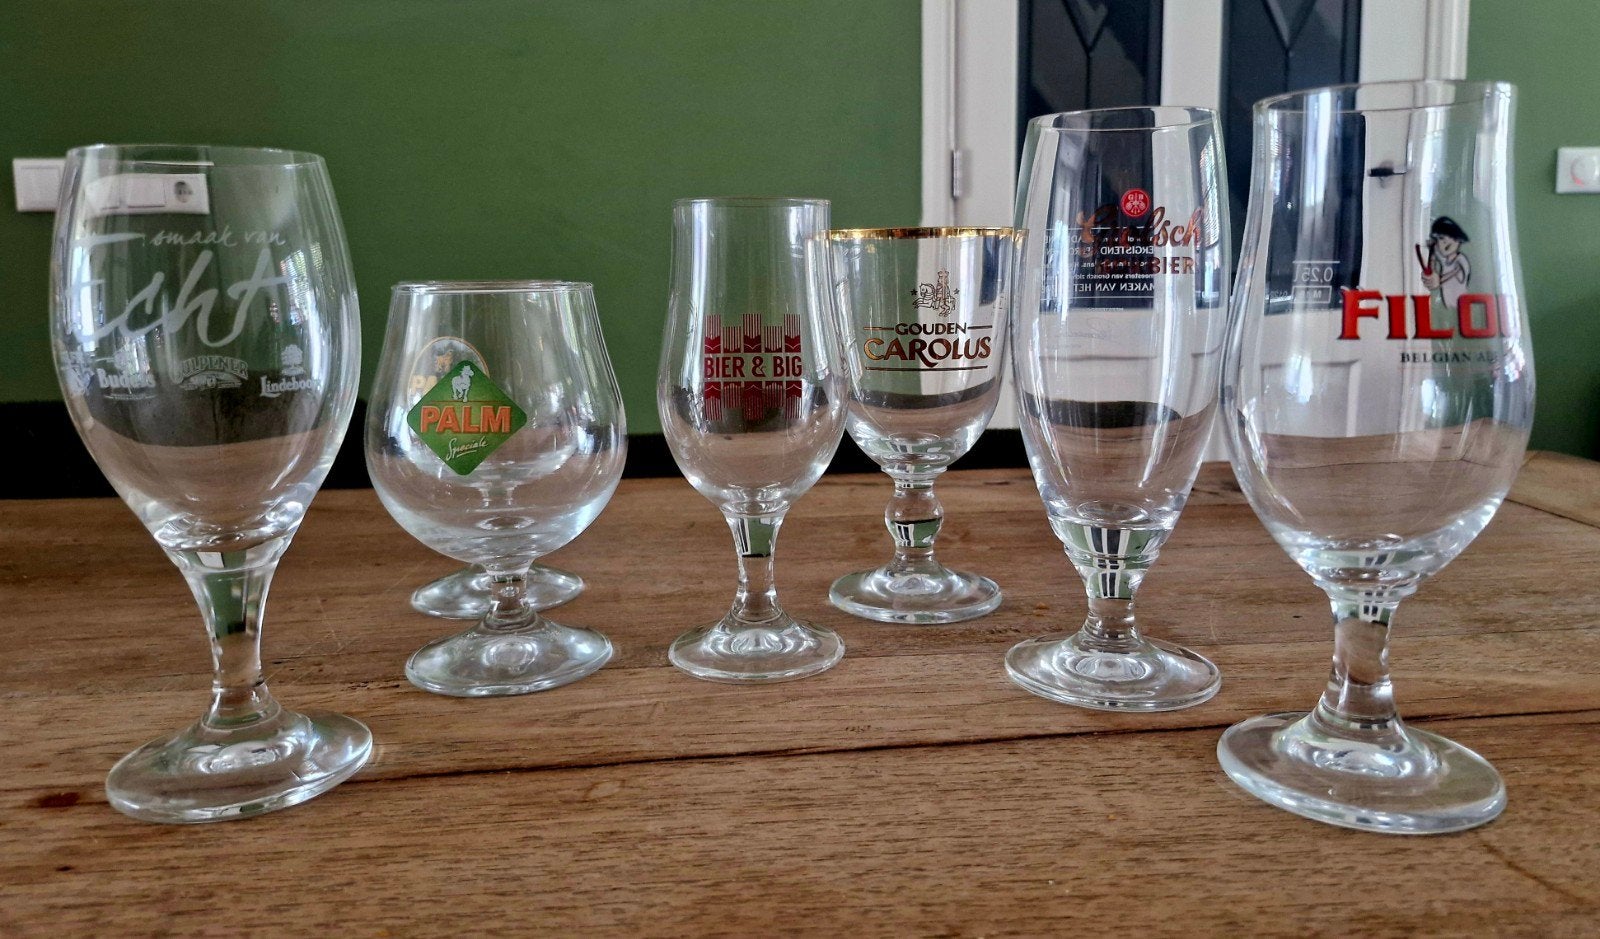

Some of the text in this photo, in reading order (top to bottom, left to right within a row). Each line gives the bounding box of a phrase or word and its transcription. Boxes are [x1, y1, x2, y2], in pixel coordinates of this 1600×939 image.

[150, 225, 286, 247] smaak van
[1076, 206, 1204, 258] Glsch
[894, 322, 968, 336] GOUDEN
[863, 336, 992, 368] CAROLUS
[1400, 351, 1472, 363] BELGIAN
[704, 356, 802, 378] BIER & BIG
[420, 405, 511, 434] PALM
[446, 435, 488, 462] Speciale
